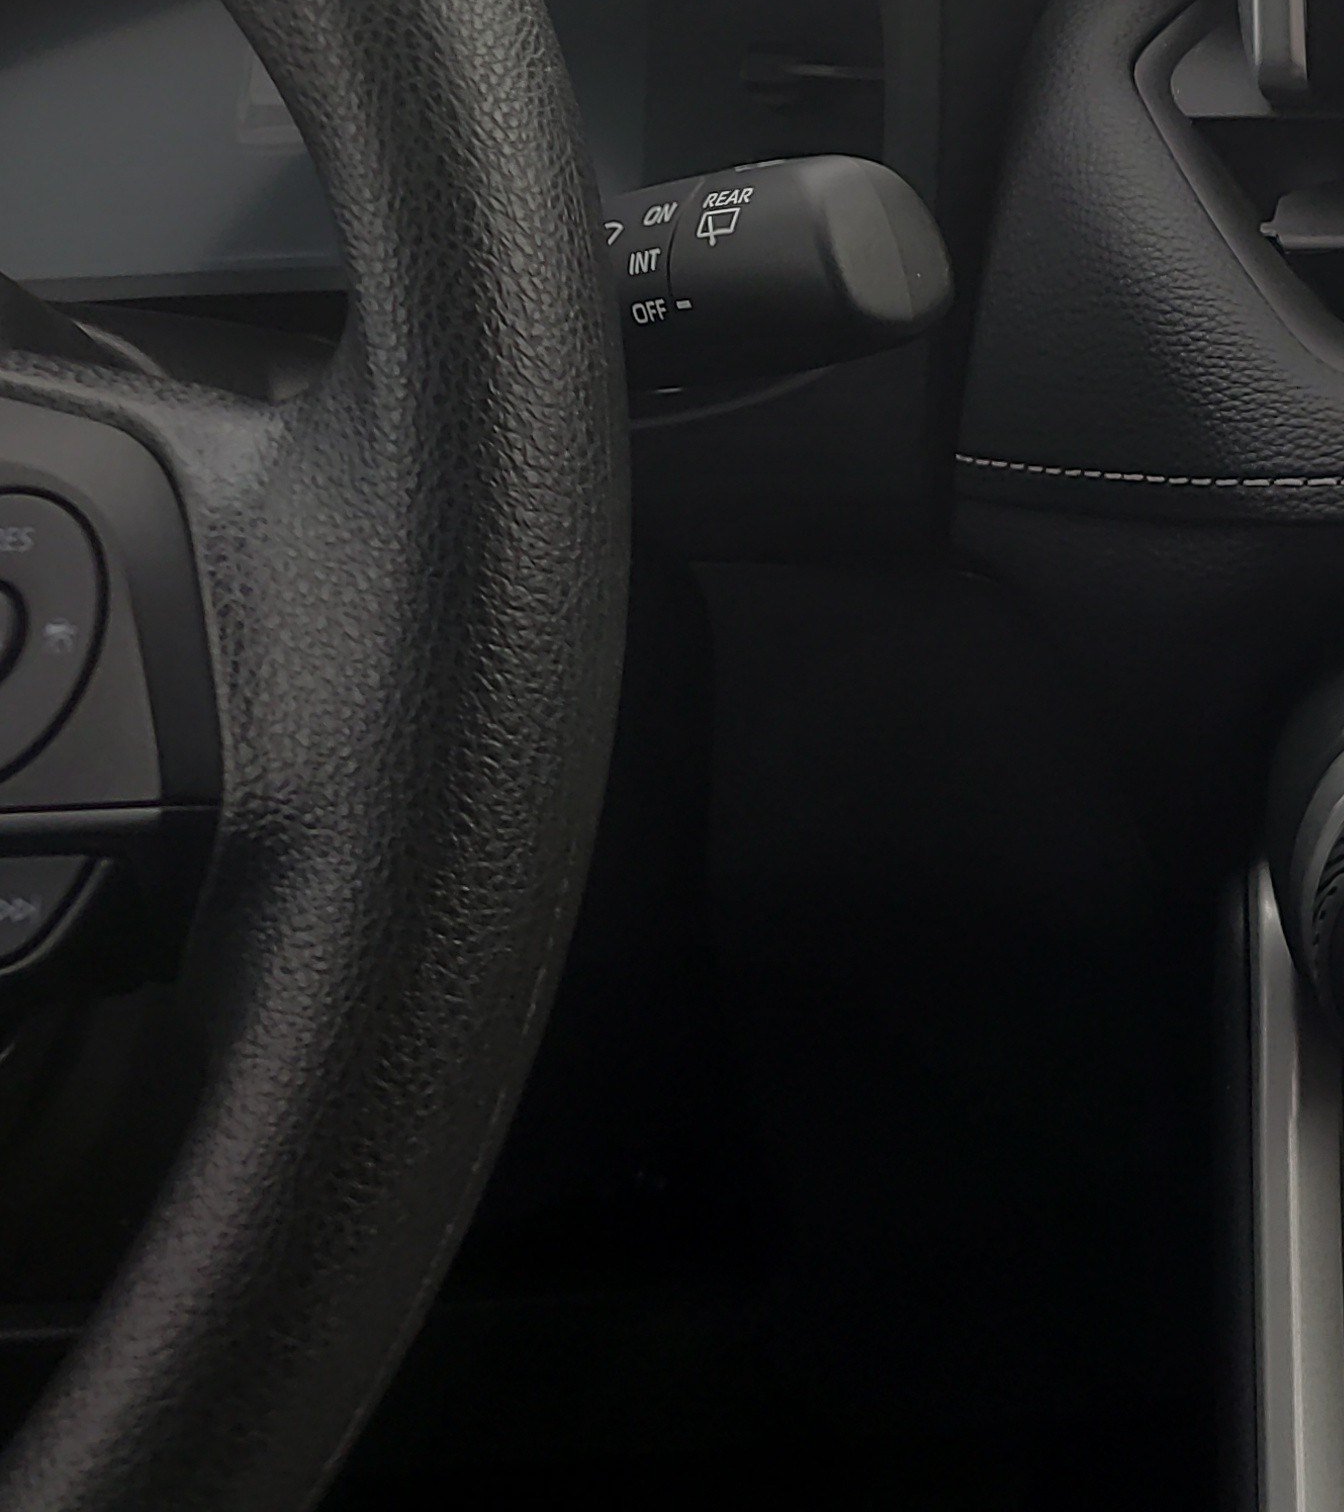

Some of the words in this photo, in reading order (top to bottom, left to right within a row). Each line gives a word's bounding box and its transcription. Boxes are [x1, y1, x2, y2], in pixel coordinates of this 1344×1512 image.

[702, 186, 754, 209] REAR
[643, 201, 678, 227] ON
[628, 247, 662, 276] INT
[631, 297, 668, 325] OFF
